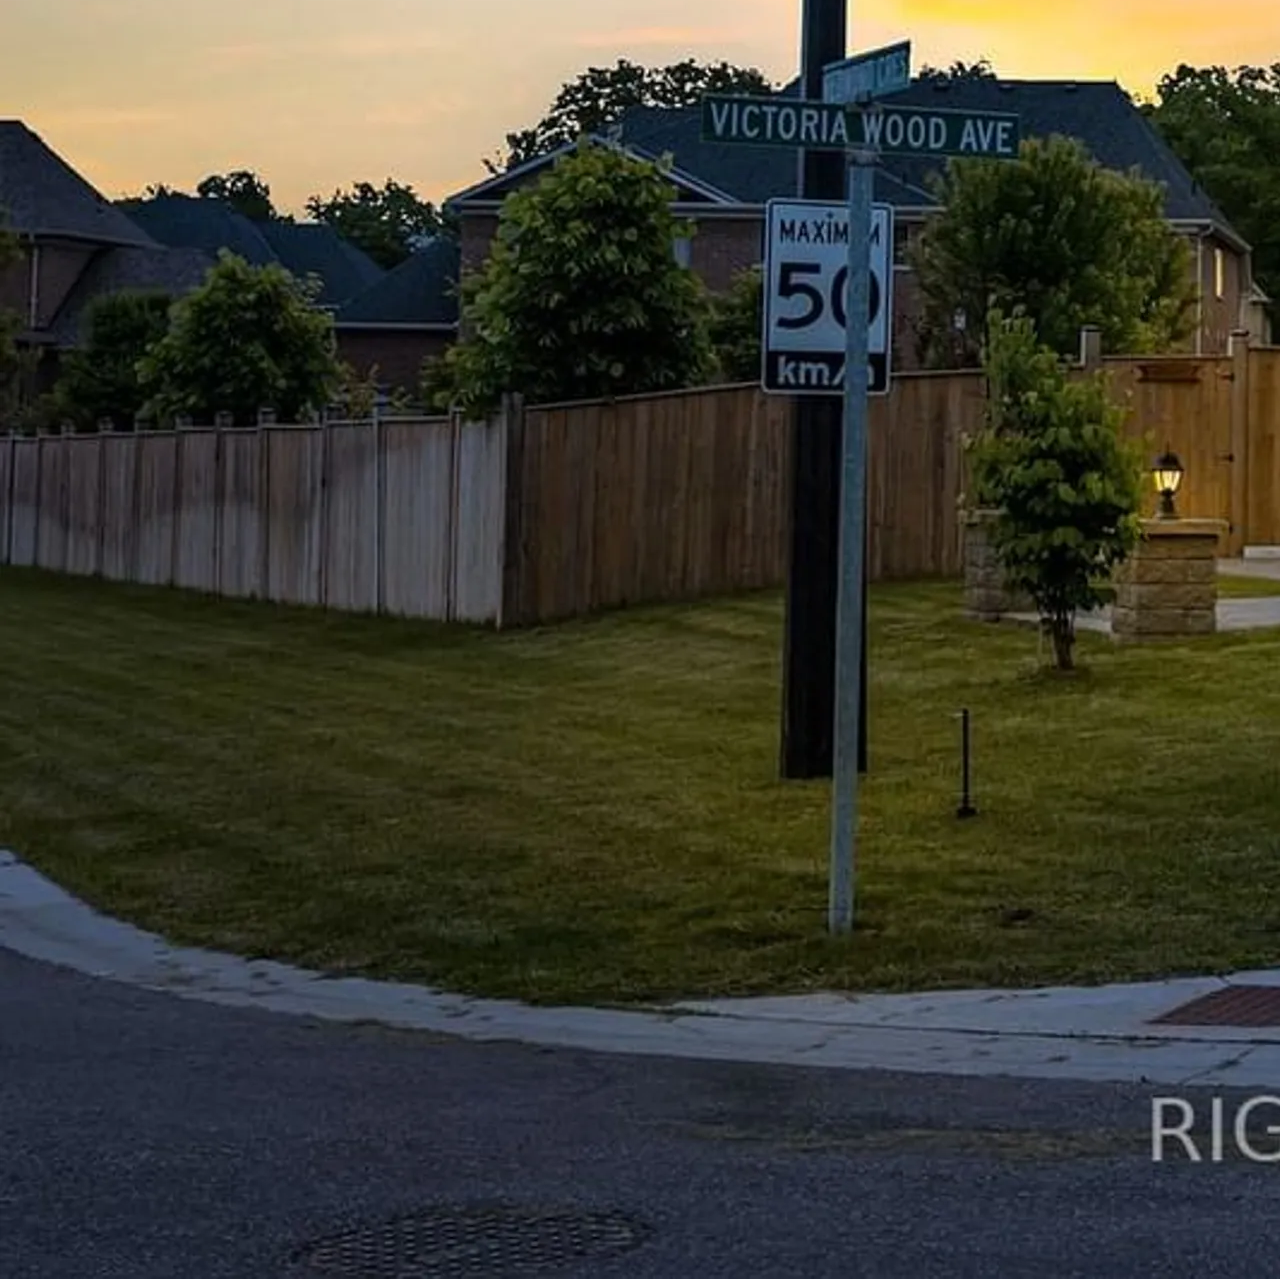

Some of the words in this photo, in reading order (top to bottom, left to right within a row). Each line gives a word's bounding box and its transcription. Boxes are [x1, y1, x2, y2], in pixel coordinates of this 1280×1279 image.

[710, 102, 849, 144] VICTORIA
[861, 113, 948, 149] WOOD
[959, 118, 1014, 153] AVE
[779, 218, 881, 247] MAXIMM
[776, 261, 881, 332] 50
